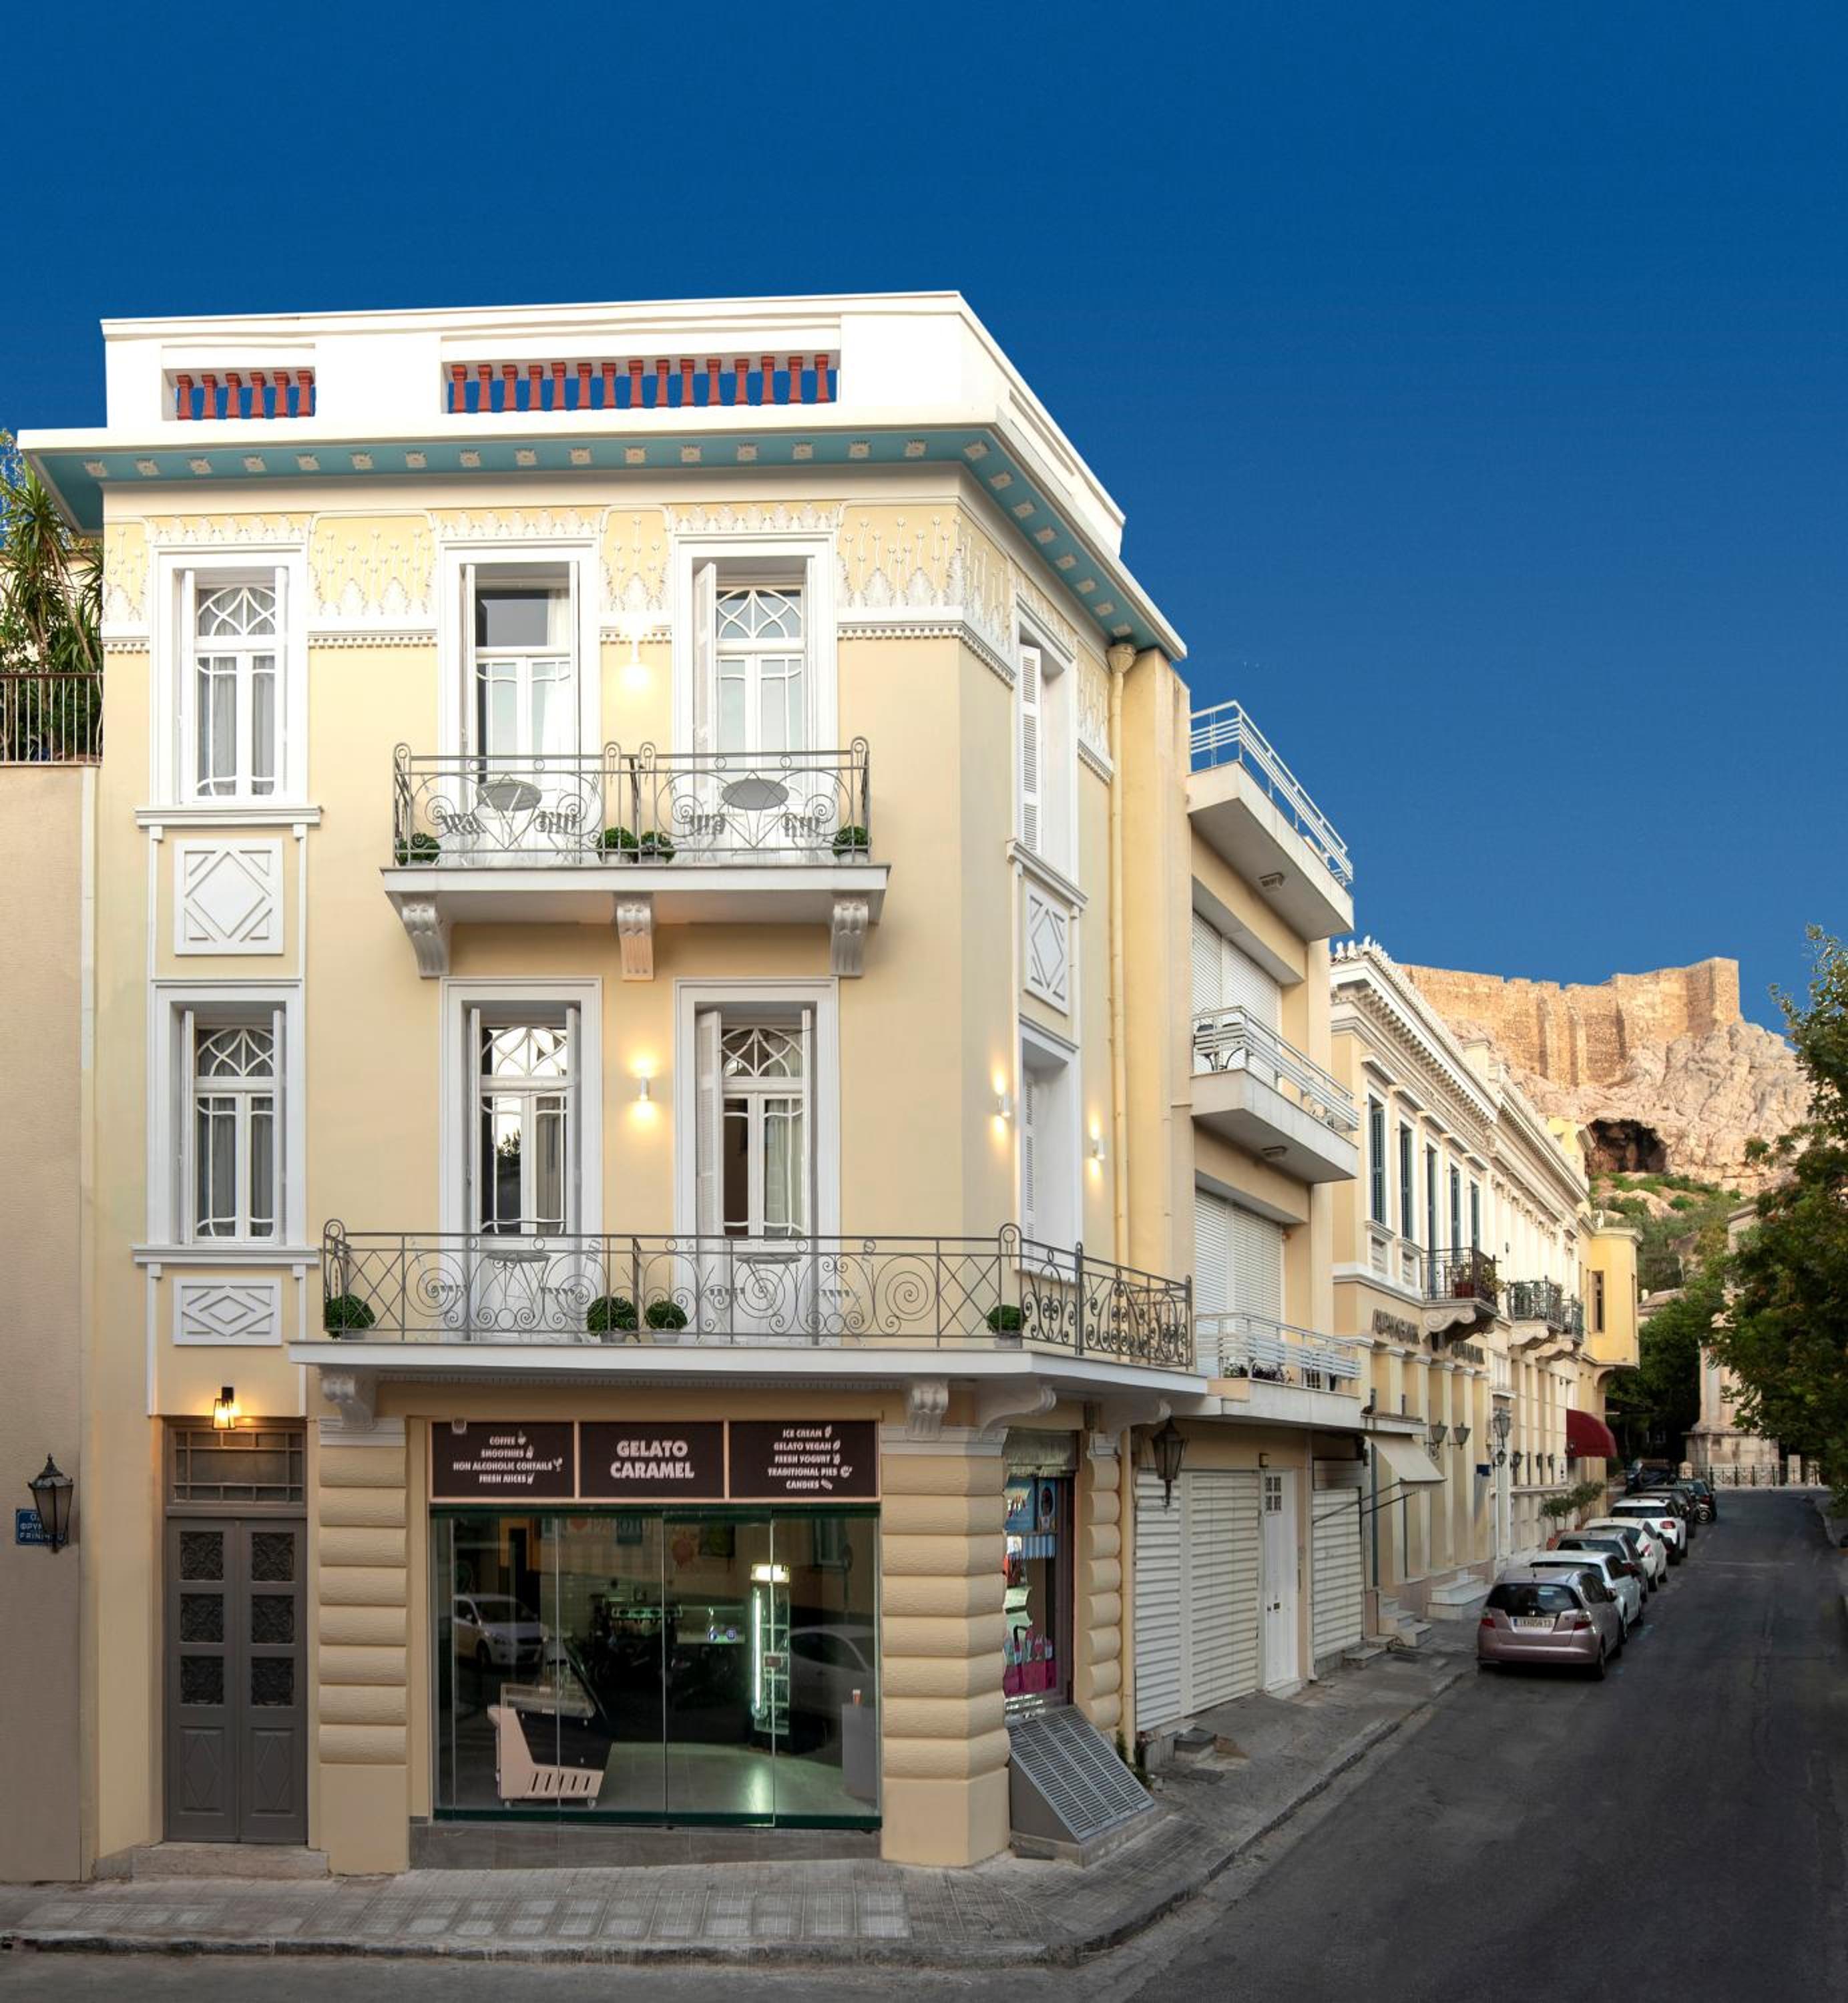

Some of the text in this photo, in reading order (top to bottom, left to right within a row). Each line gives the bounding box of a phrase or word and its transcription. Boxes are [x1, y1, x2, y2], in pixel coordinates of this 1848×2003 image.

[782, 1429, 822, 1438] ICE CREAM
[489, 1435, 515, 1445] COFFEE
[616, 1439, 688, 1458] GELATO
[774, 1441, 831, 1451] GELATO VEGAN
[481, 1448, 524, 1458] SMOOTHIES
[774, 1454, 798, 1464] FRESH
[453, 1461, 471, 1471] NON
[472, 1461, 515, 1471] ALCOHOLIC
[610, 1460, 694, 1479] CARAMEL
[768, 1467, 838, 1477] TRADITIONAL PIES
[479, 1474, 527, 1484] FRESH JUICES
[786, 1480, 820, 1490] CANDIES
